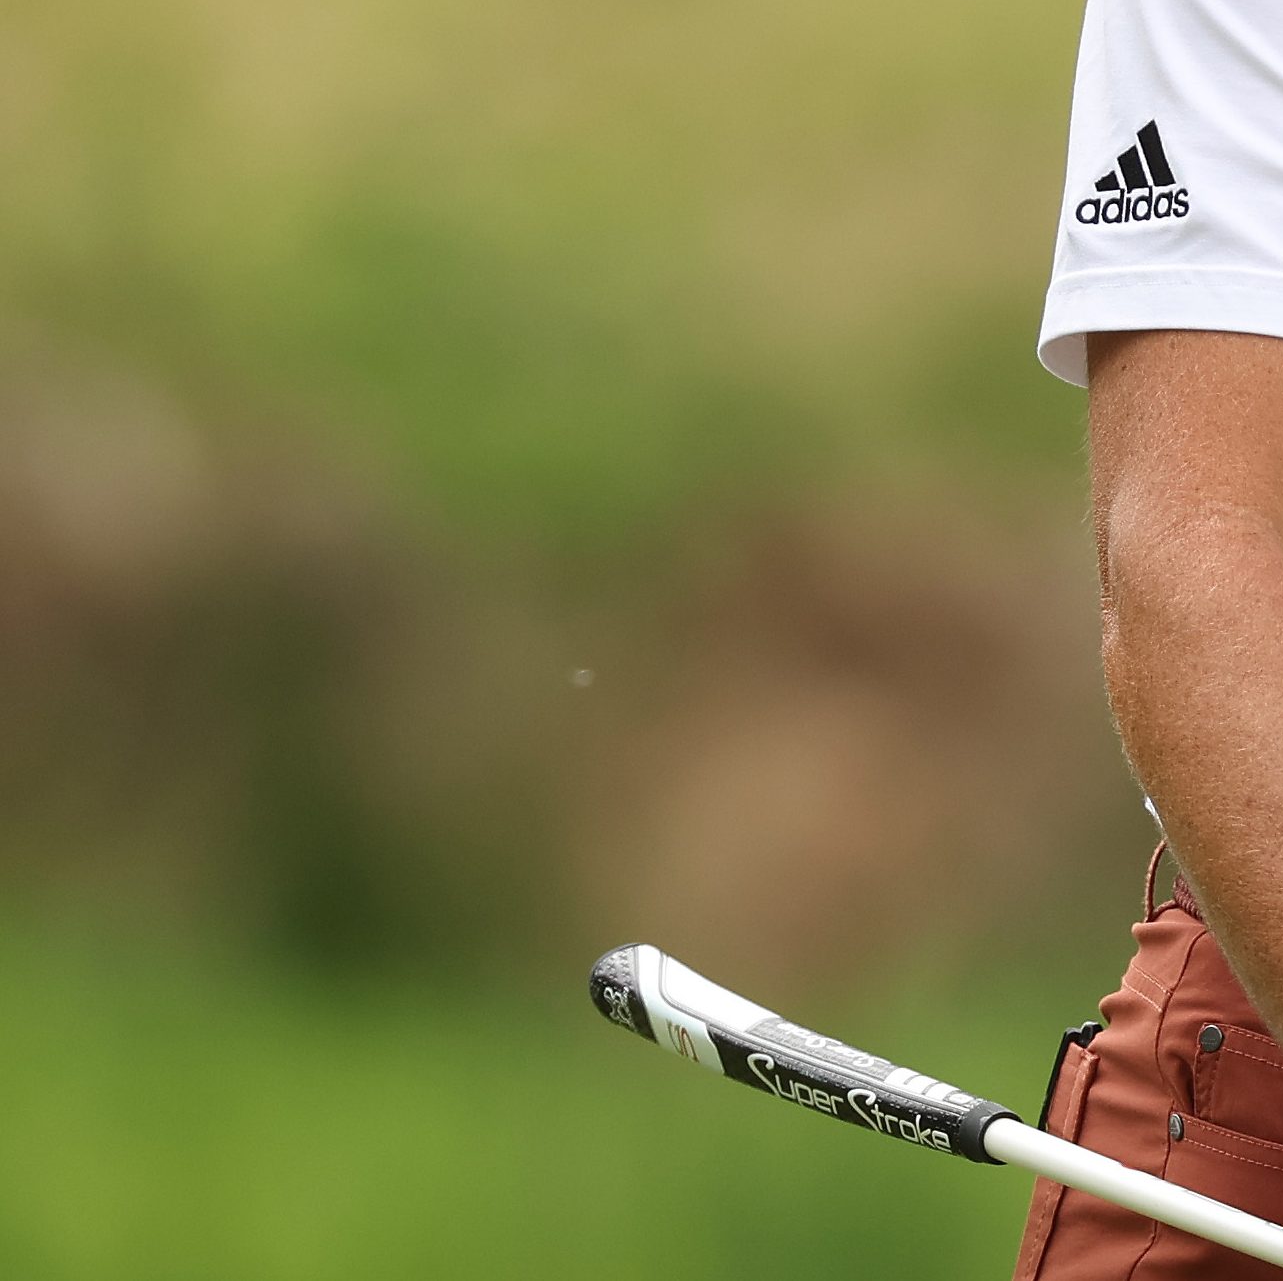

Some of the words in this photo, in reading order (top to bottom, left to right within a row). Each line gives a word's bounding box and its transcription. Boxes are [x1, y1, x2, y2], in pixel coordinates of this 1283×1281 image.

[1076, 185, 1189, 224] adidas
[747, 1053, 843, 1116] Super
[848, 1088, 952, 1153] Stroke
